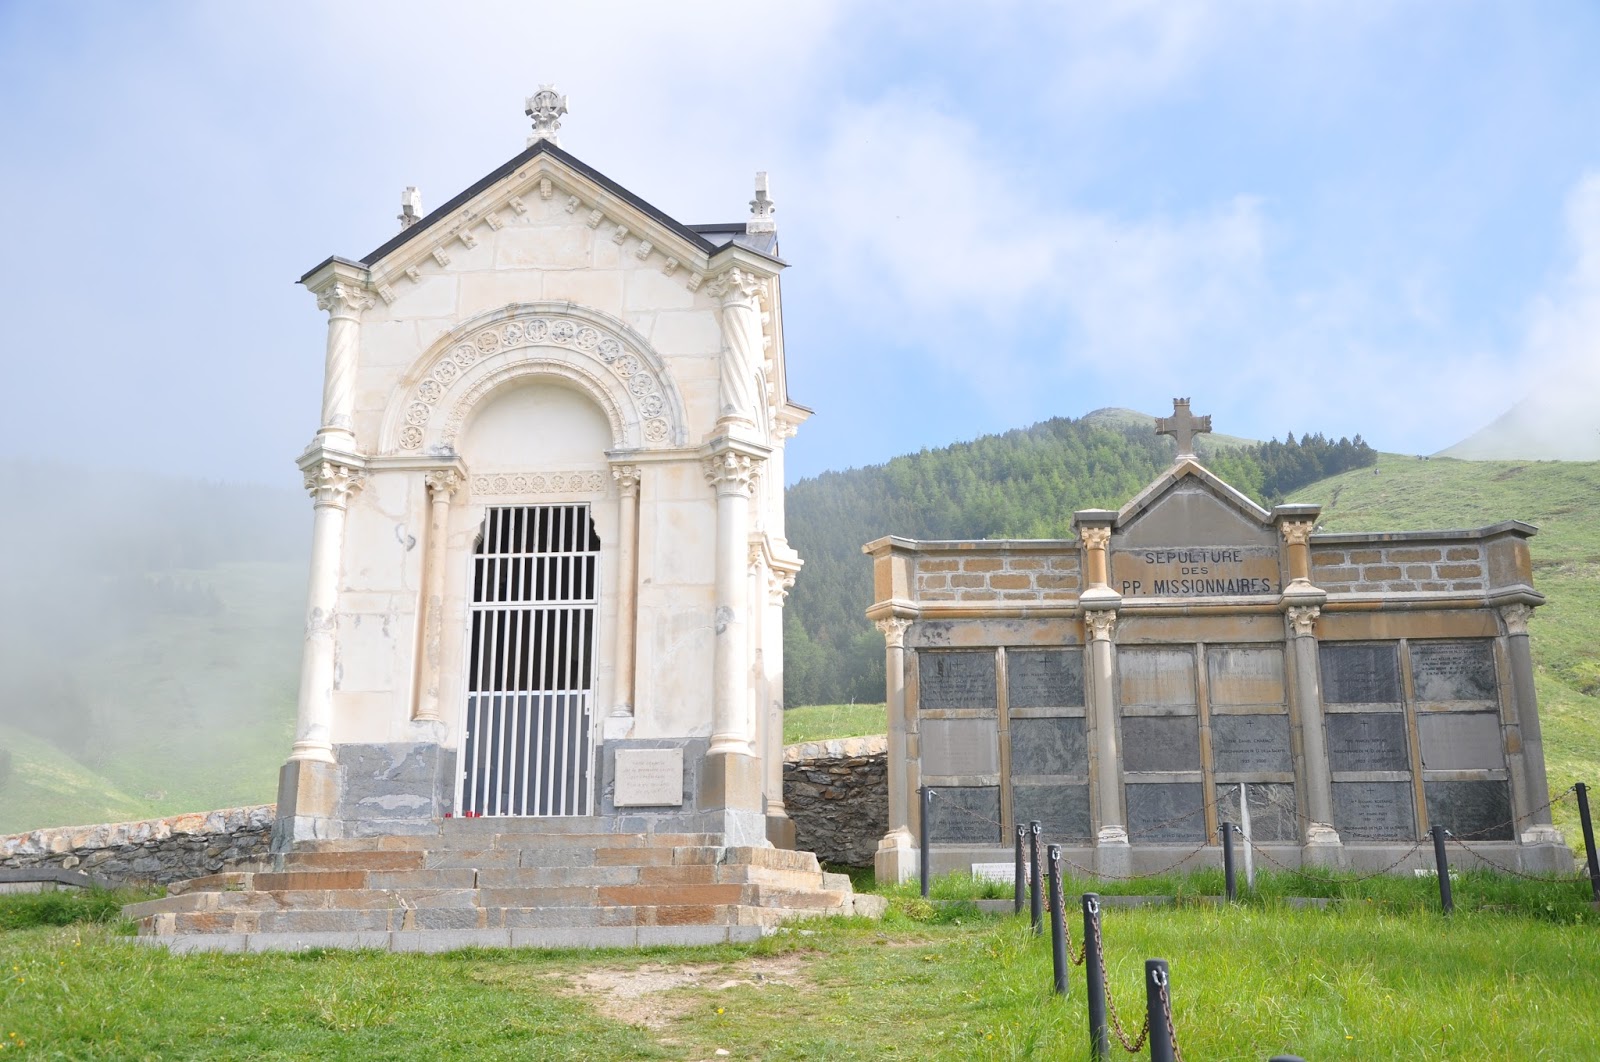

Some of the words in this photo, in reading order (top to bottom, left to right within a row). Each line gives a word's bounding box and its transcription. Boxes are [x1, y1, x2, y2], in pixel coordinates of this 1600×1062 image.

[1145, 551, 1242, 564] SEPULTURE
[1181, 567, 1208, 575] DES
[1122, 580, 1146, 595] PP.
[1154, 578, 1270, 594] MISSIONNAIRES
